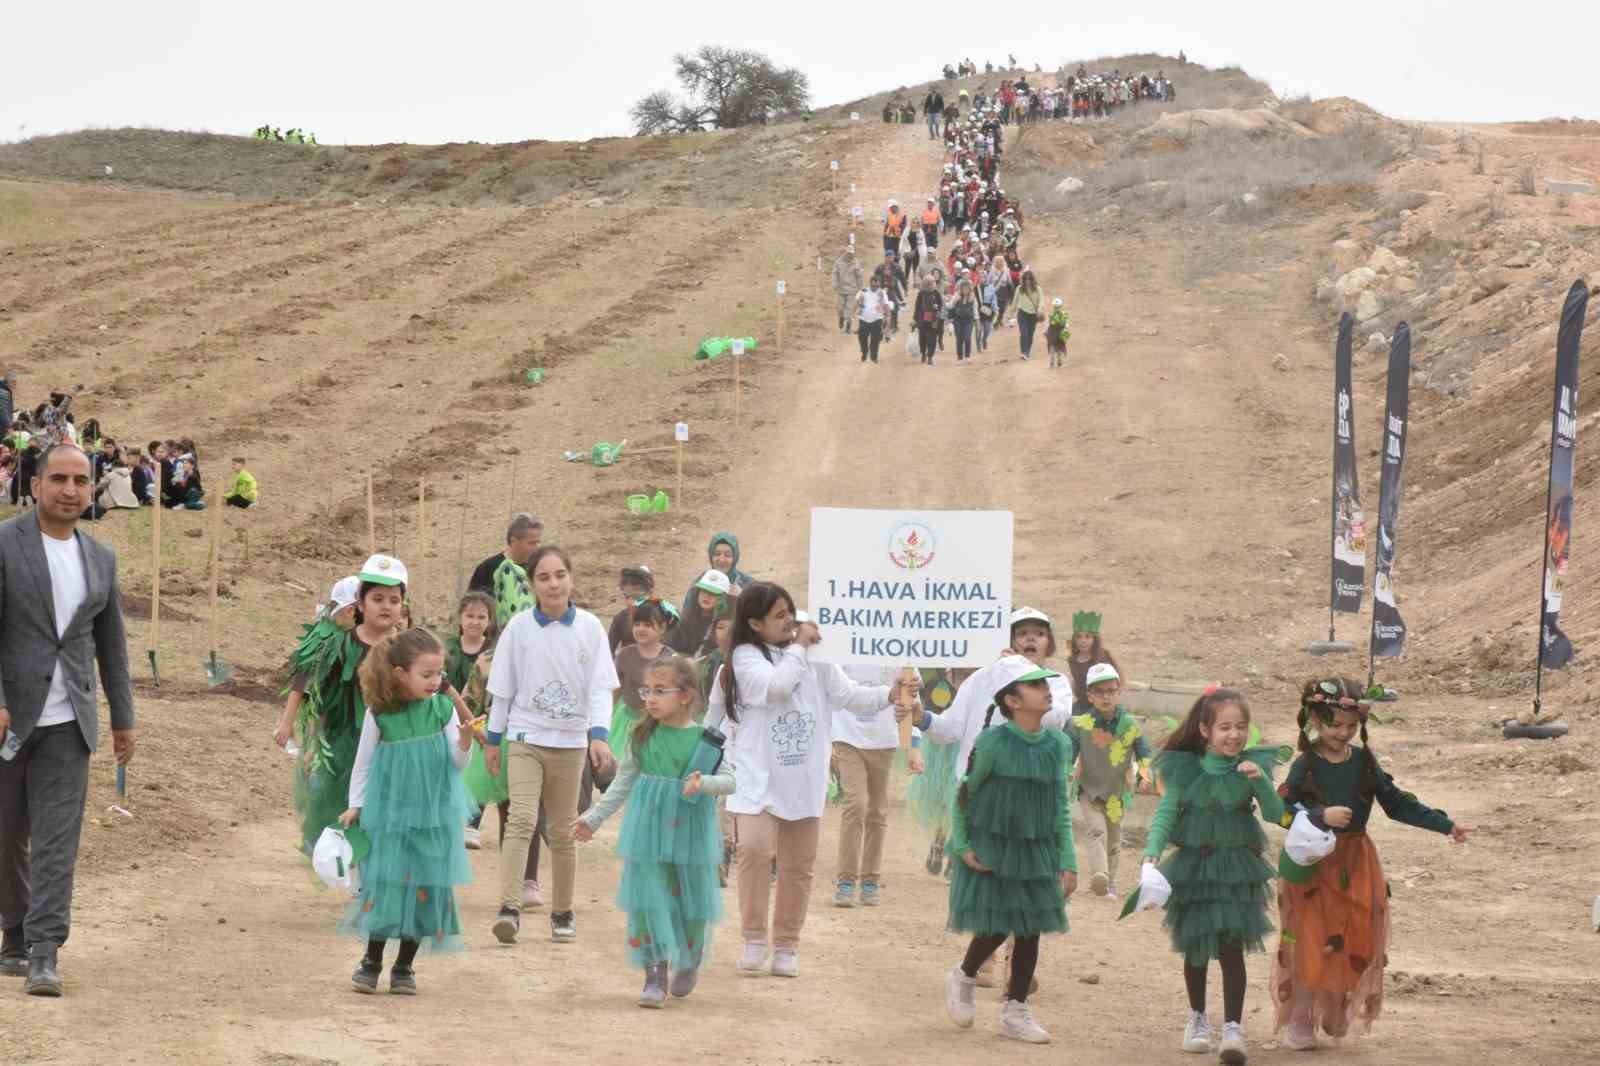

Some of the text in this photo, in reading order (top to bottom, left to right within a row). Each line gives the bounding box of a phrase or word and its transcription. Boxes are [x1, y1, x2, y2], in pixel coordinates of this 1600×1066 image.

[829, 578, 996, 601] 1.HAVA İKMAL
[819, 606, 1001, 629] BAKIM MERKEZİ
[852, 633, 967, 657] İLKOKULU
